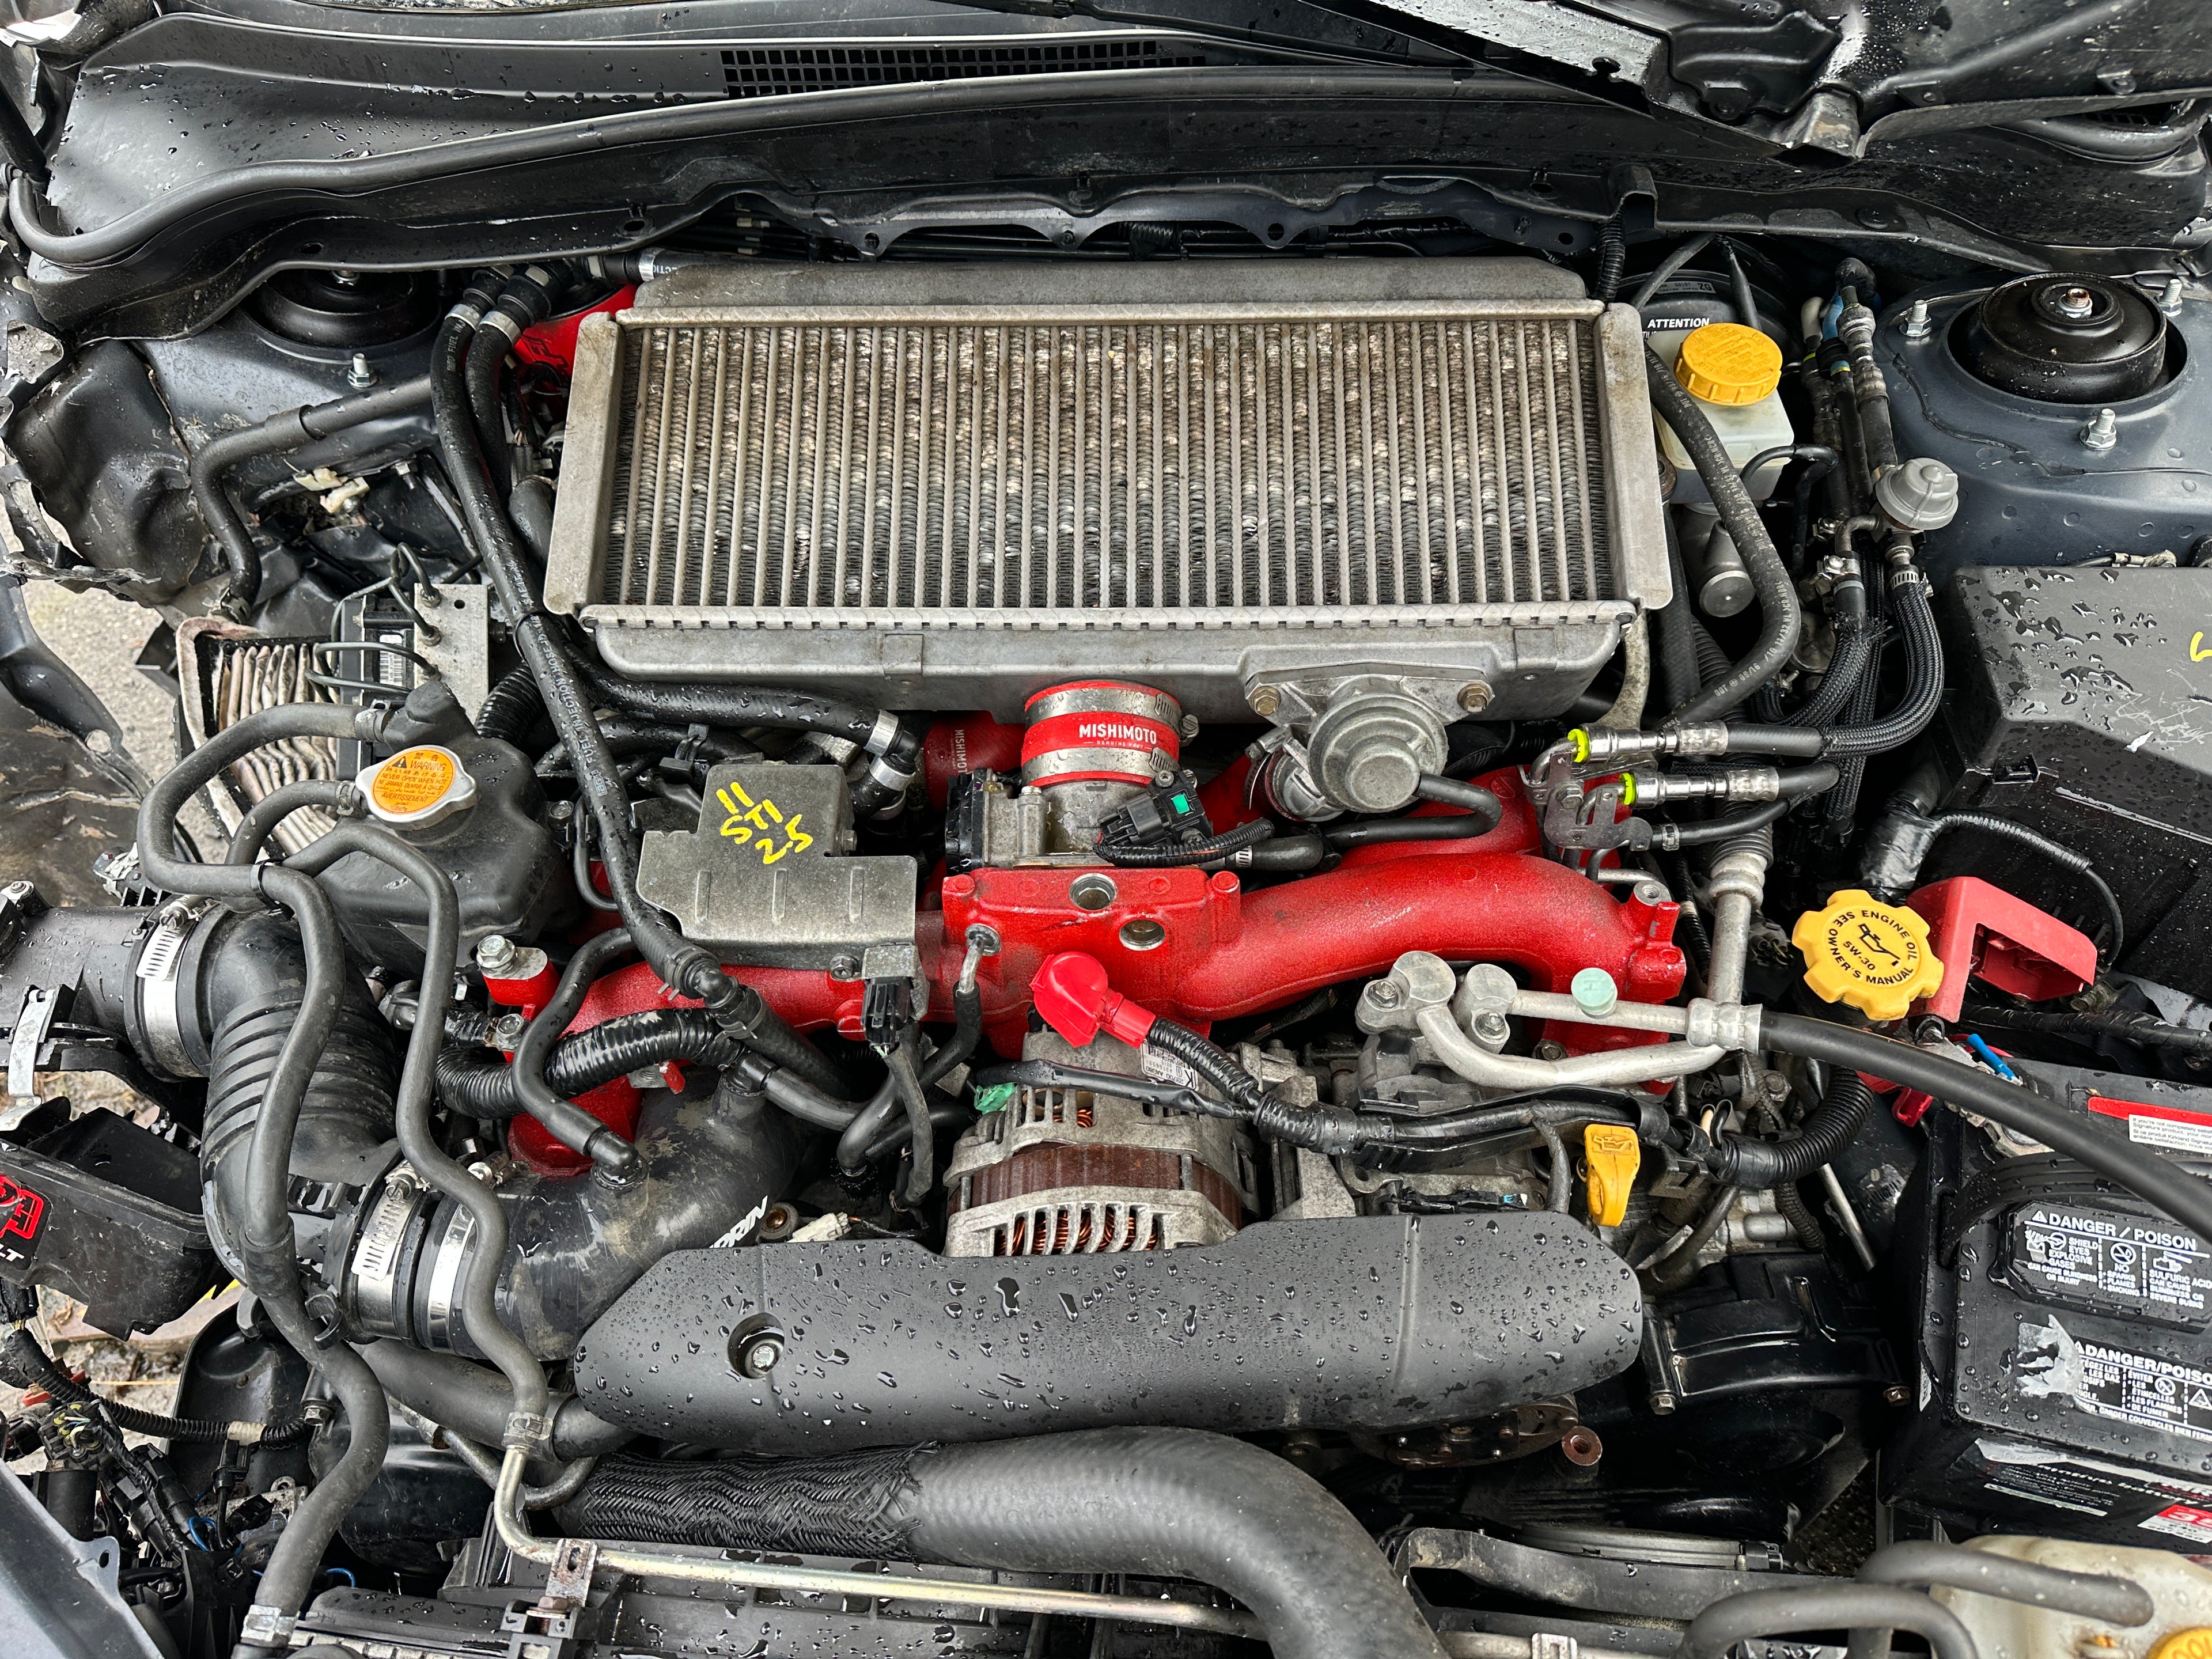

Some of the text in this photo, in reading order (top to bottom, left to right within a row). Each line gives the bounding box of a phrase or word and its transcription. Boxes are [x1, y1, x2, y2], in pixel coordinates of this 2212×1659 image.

[1647, 317, 1710, 328] ATTENTION
[448, 336, 459, 353] FUEL
[543, 646, 562, 673] HOSE
[555, 674, 585, 730] INJECTION
[1079, 724, 1157, 745] MISHIMOTO
[578, 736, 596, 764] FUEL
[955, 729, 968, 773] MISHIMOT
[410, 760, 446, 771] WARNING
[381, 792, 429, 803] AVERTISSEMENT
[720, 799, 783, 844] STI
[1861, 910, 1918, 960] ENGINE OIL
[1828, 911, 1914, 985] SEE OWNER'S MANUAL
[1843, 941, 1876, 971] 5W-30
[2133, 1123, 2160, 1131] Signature
[2166, 1123, 2195, 1132] completely
[2049, 1213, 2196, 1251] DANGER / POISON
[2069, 1237, 2099, 1249] SHIELD
[2069, 1246, 2090, 1256] EYES
[2048, 1258, 2075, 1270] GASES
[2049, 1249, 2093, 1265] EXPLOSIVE
[2028, 1262, 2097, 1283] CAN CAUSE BLINDNESS
[2107, 1270, 2136, 1282] SPARKS
[2114, 1263, 2130, 1273] NO
[2058, 1275, 2080, 1286] INJURY
[2107, 1278, 2135, 1288] FLAMES
[2149, 1269, 2212, 1289] SULFURIC ACID
[2149, 1278, 2191, 1292] CAN CAUSE
[2107, 1285, 2140, 1297] SMOKING
[2150, 1285, 2205, 1301] BLINDNESS OR
[2150, 1292, 2204, 1309] SEVERE BURNS
[2089, 1369, 2120, 1384] LES GAZ
[2104, 1365, 2119, 1375] LES
[2128, 1369, 2154, 1383] ÉVITER
[2132, 1380, 2146, 1389] LES
[2132, 1386, 2175, 1404] ÉTINCELLES
[2131, 1403, 2168, 1419] DE FUMER
[2132, 1396, 2183, 1415] LES FLAMMES
[2099, 1406, 2127, 1421] GARDER
[2128, 1414, 2175, 1433] COUVERCLES
[2175, 1426, 2191, 1437] BIEN
